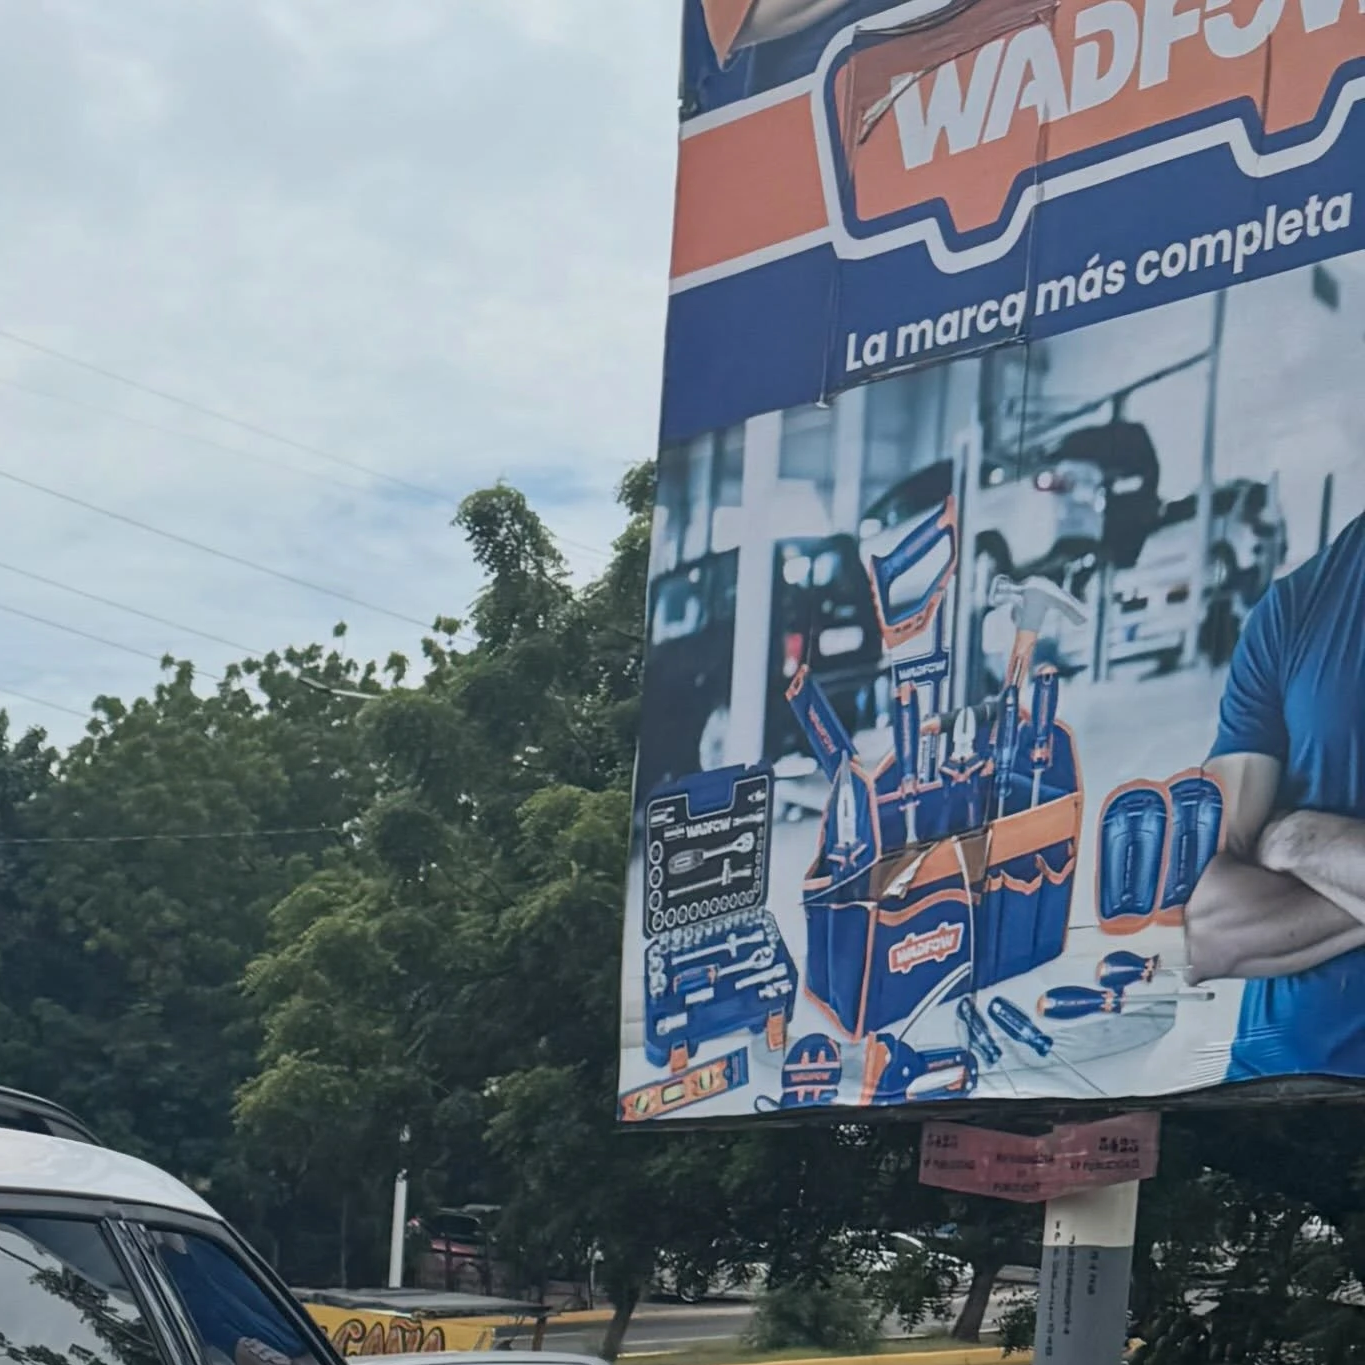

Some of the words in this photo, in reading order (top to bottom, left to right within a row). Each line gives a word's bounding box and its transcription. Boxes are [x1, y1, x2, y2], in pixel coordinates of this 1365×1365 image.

[890, 0, 1365, 171] WADFO
[845, 331, 886, 372] La
[895, 291, 1026, 359] marca
[1035, 254, 1126, 318] más
[1135, 190, 1353, 286] completa
